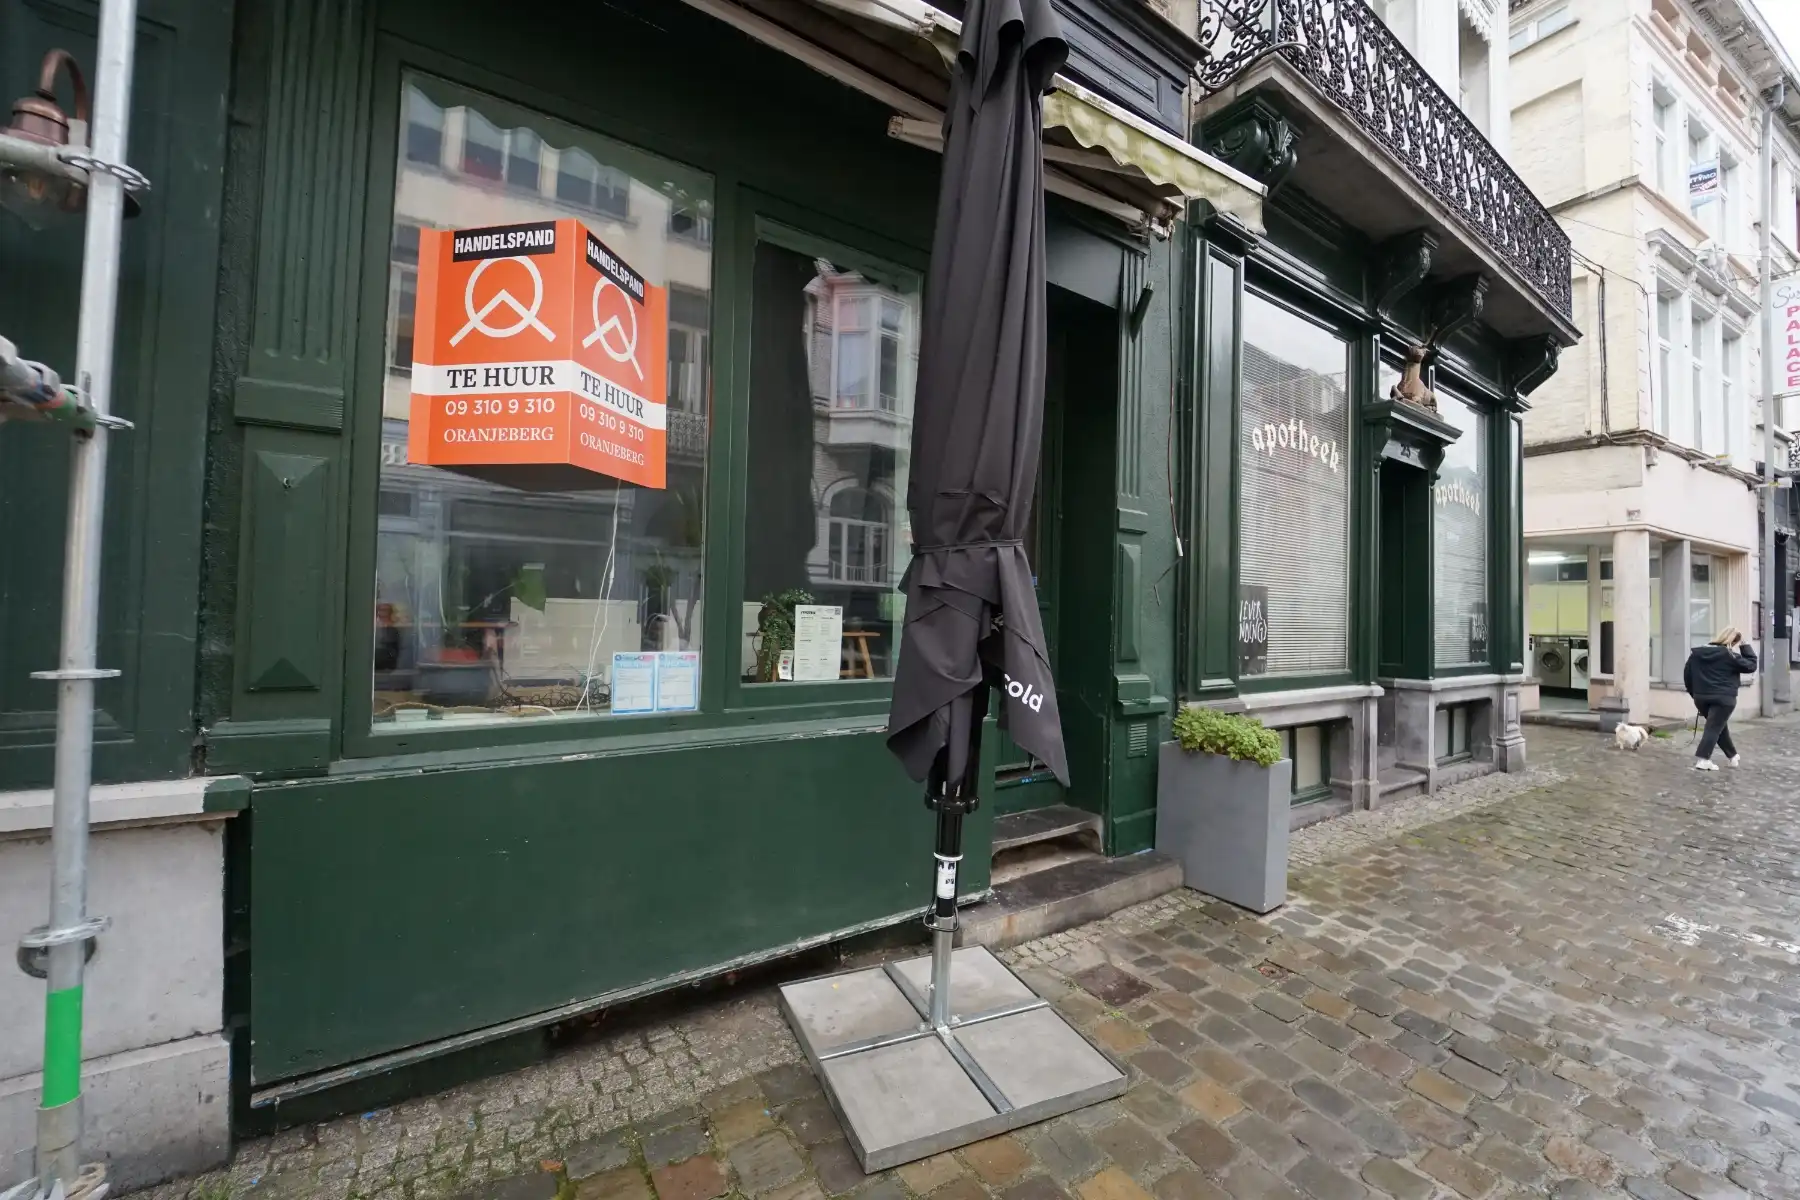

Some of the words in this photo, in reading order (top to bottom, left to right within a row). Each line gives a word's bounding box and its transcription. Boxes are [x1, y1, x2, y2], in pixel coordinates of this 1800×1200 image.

[455, 229, 554, 253] HANDELSPAND
[587, 238, 644, 298] HANDELSPAND
[447, 368, 477, 389] TE
[483, 366, 555, 387] HUUR
[580, 371, 601, 398] TE
[605, 383, 644, 418] HUUR
[445, 400, 468, 416] 09
[473, 399, 502, 415] 310
[508, 399, 519, 414] 9
[525, 398, 555, 414] 310
[580, 403, 596, 422] 09
[598, 411, 617, 431] 310
[619, 420, 626, 434] 9
[628, 424, 644, 442] 310
[443, 426, 555, 443] ORANJEBERG
[580, 432, 645, 466] ORANJEBERG
[1252, 418, 1339, 473] apotheek
[1435, 478, 1480, 516] apotheek
